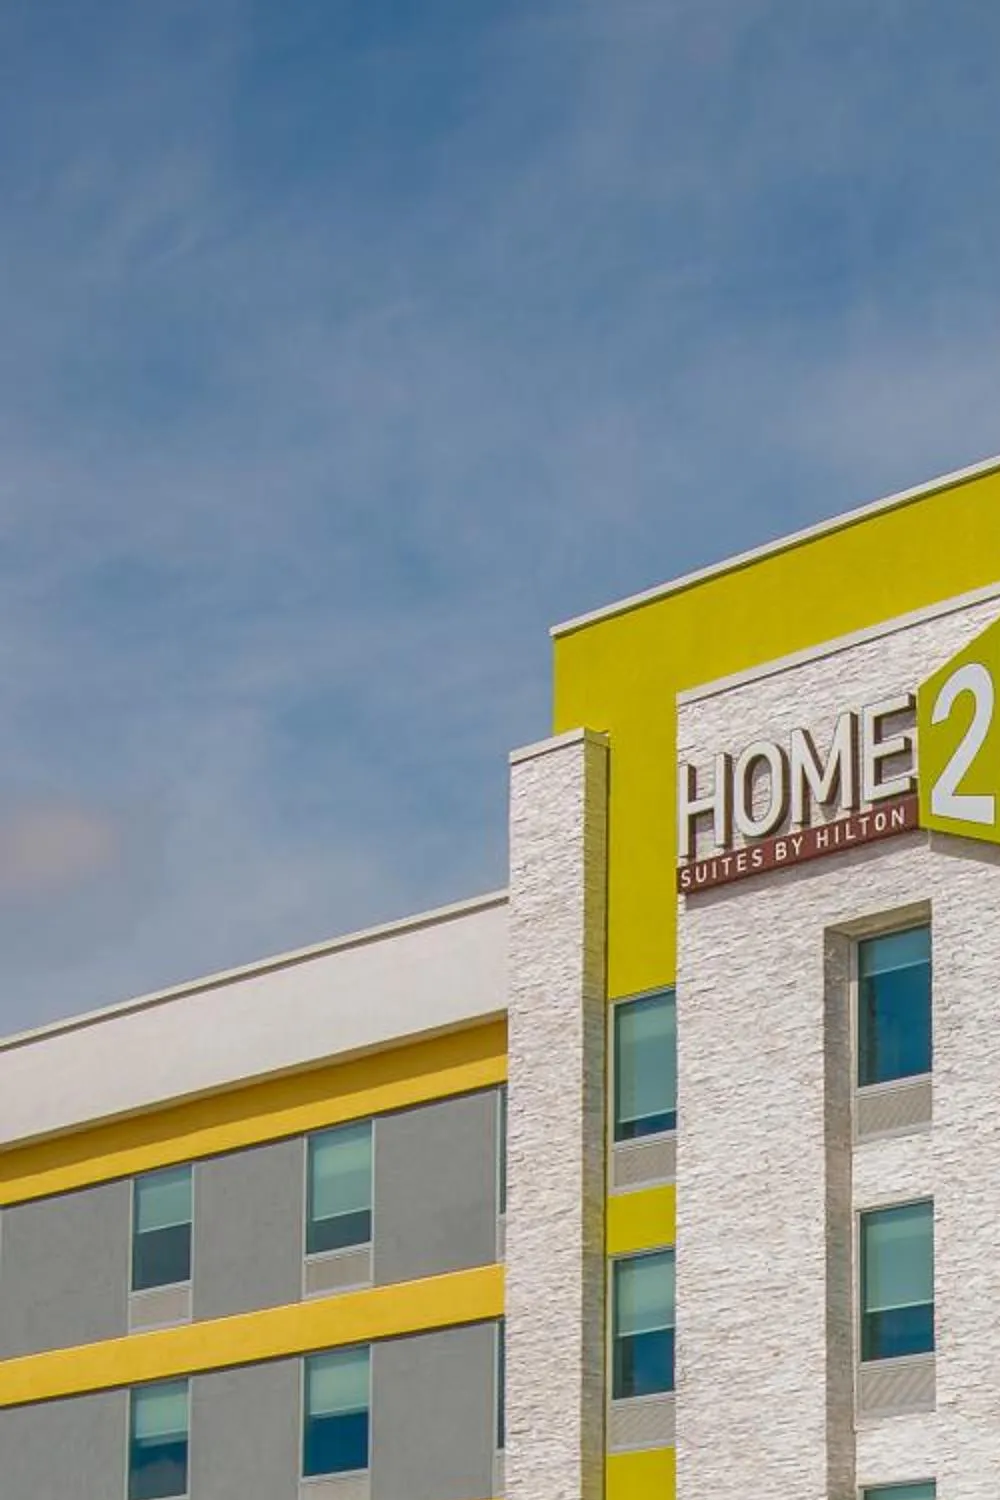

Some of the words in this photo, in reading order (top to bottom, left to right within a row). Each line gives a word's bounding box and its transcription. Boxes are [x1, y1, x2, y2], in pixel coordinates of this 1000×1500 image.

[678, 694, 915, 857] HOME
[931, 663, 995, 826] 2
[681, 850, 763, 888] SUITES
[775, 837, 803, 861] BY
[816, 806, 905, 849] HILTON
